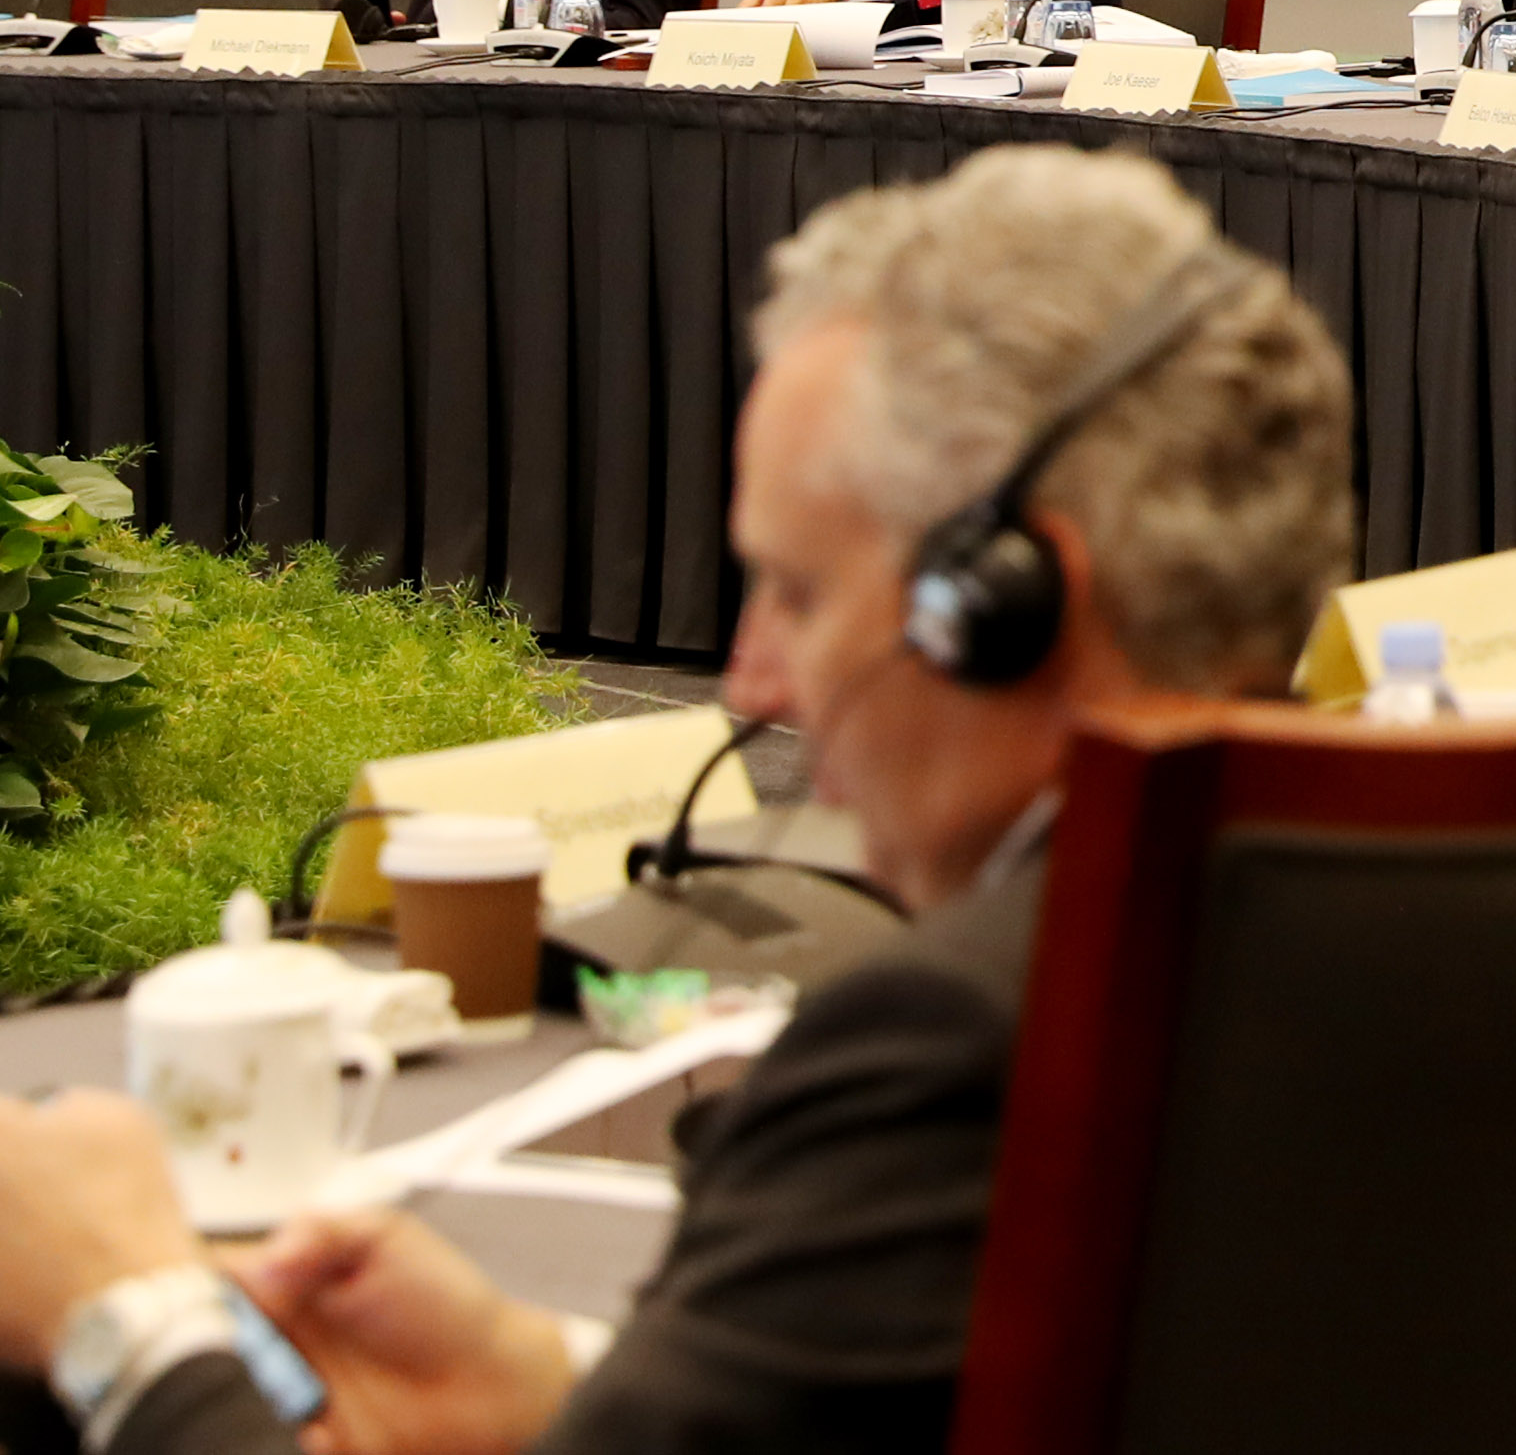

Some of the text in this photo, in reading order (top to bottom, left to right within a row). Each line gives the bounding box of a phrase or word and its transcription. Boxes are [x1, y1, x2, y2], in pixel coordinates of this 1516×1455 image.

[210, 37, 310, 55] Michael Diekmann
[686, 50, 756, 70] Koichi Miyata
[1103, 71, 1161, 88] Joe Kaeser
